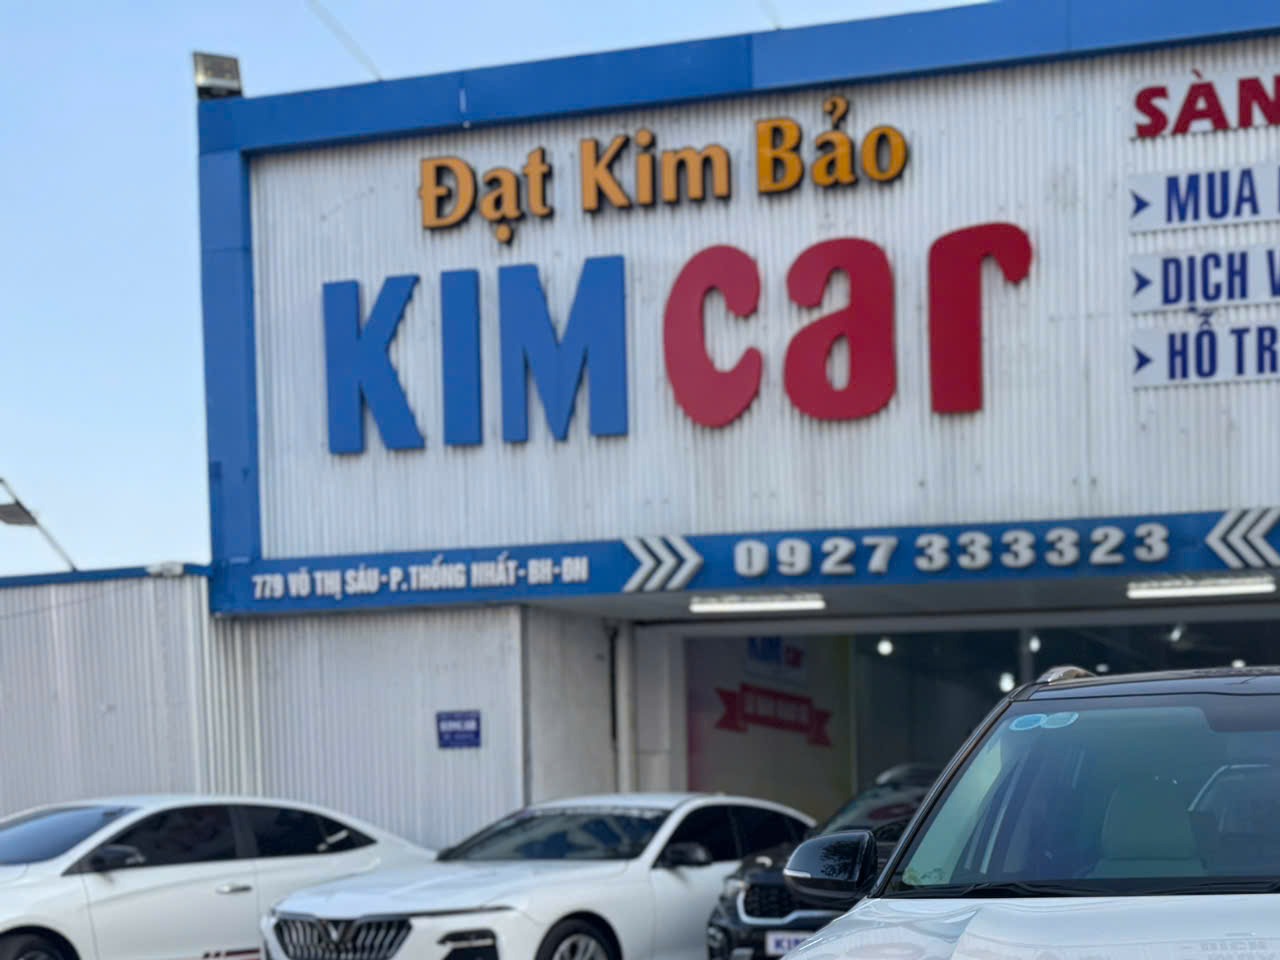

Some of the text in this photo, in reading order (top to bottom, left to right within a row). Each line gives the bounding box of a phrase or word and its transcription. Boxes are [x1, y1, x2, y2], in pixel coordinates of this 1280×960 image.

[419, 95, 908, 243] Đạt Kim Bảo
[1165, 168, 1260, 223] MUA
[1161, 251, 1249, 313] DỊCH
[322, 221, 1034, 454] KIM car
[1167, 311, 1218, 381] HỖ
[733, 522, 1170, 578] 0927 333323
[252, 573, 284, 600] 779
